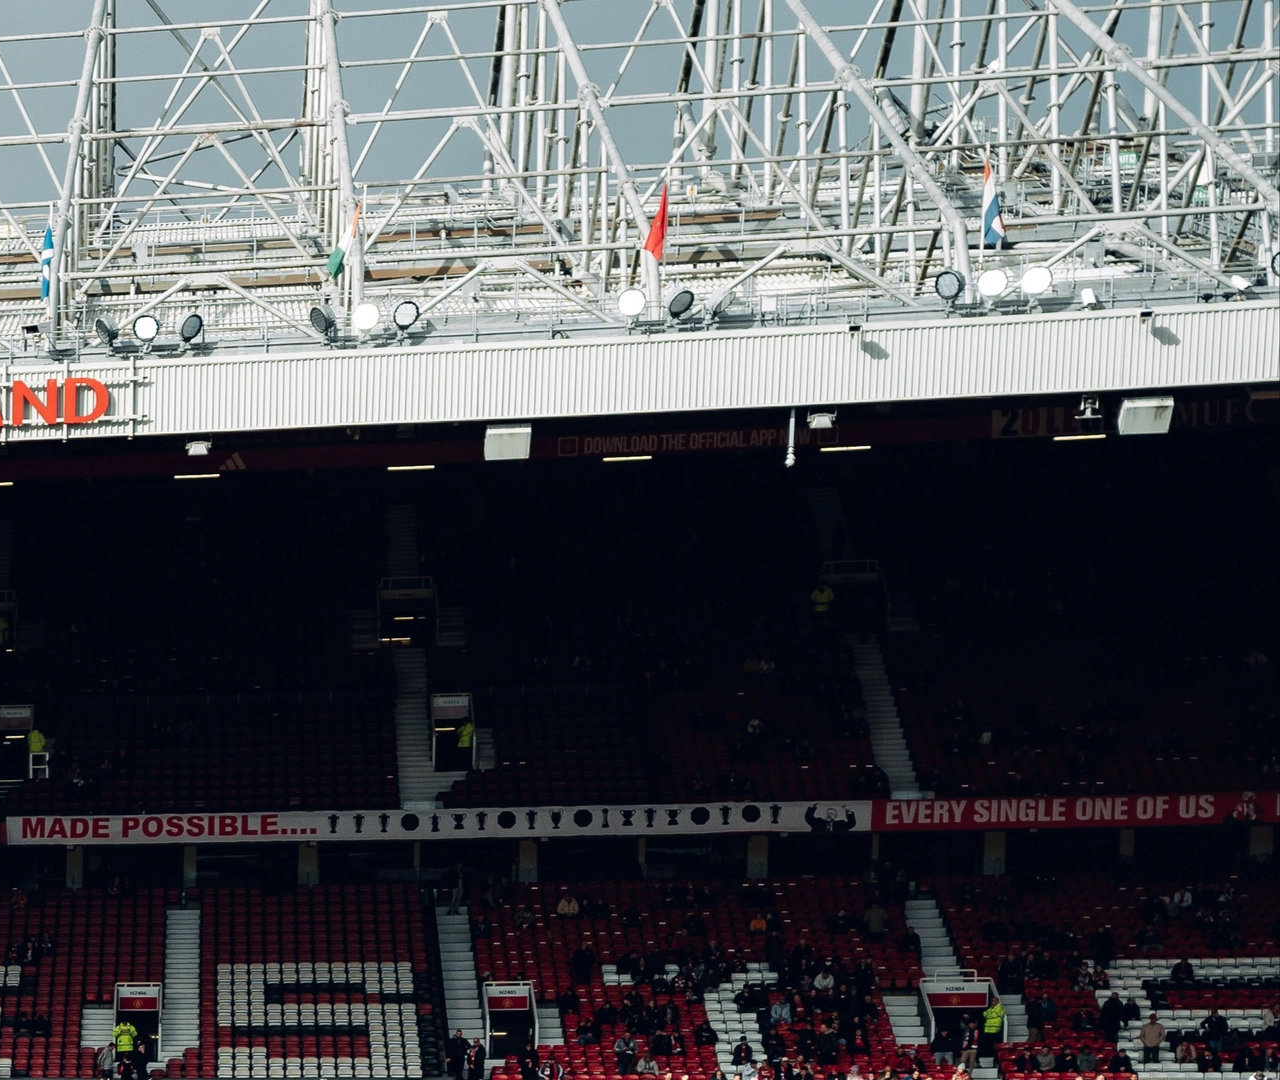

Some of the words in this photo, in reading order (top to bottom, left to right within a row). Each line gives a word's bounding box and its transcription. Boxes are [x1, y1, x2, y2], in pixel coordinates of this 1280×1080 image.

[1174, 397, 1264, 428] MUFC
[584, 434, 658, 454] DOWNLOAD
[660, 433, 687, 451] THE
[689, 430, 746, 450] OFFICIAL
[749, 429, 777, 447] APP
[779, 427, 811, 445] NW
[885, 800, 967, 824] EVERY
[973, 797, 1067, 823] SINGLE
[1075, 797, 1128, 821] ONE
[1136, 795, 1170, 819] OF
[1178, 794, 1215, 818] US
[22, 818, 110, 839] MADE
